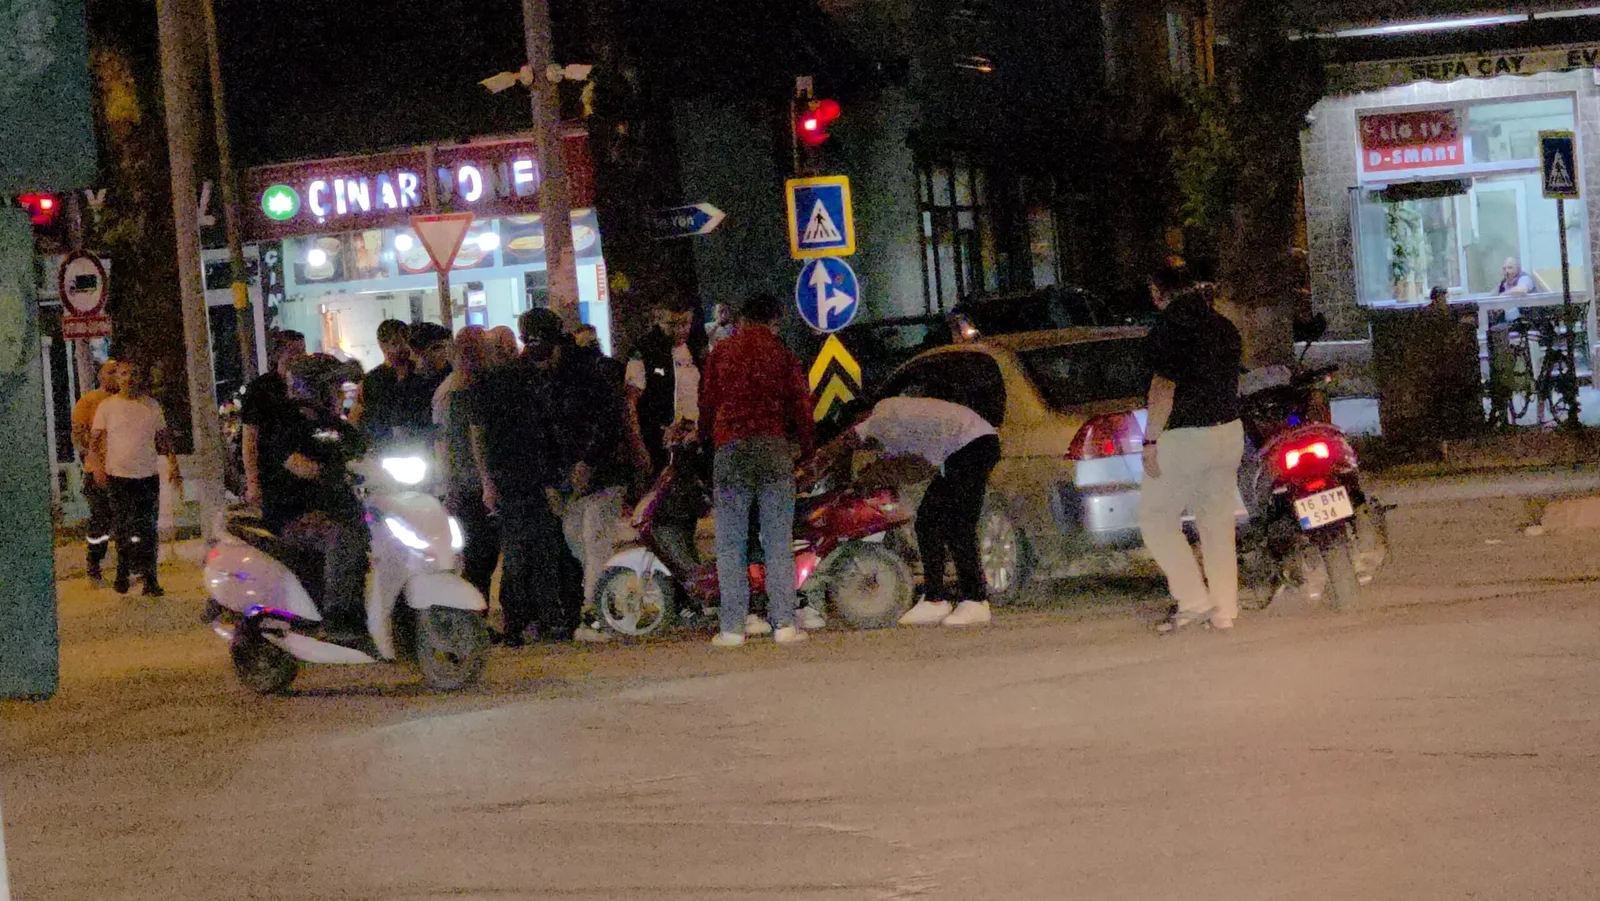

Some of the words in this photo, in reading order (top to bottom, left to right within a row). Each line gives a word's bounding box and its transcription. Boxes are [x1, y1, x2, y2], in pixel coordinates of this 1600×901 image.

[1369, 145, 1457, 166] D-SMART
[308, 170, 421, 224] ÇINAR
[1300, 499, 1316, 513] 16
[1320, 489, 1346, 506] BYM
[1314, 507, 1338, 523] 534
